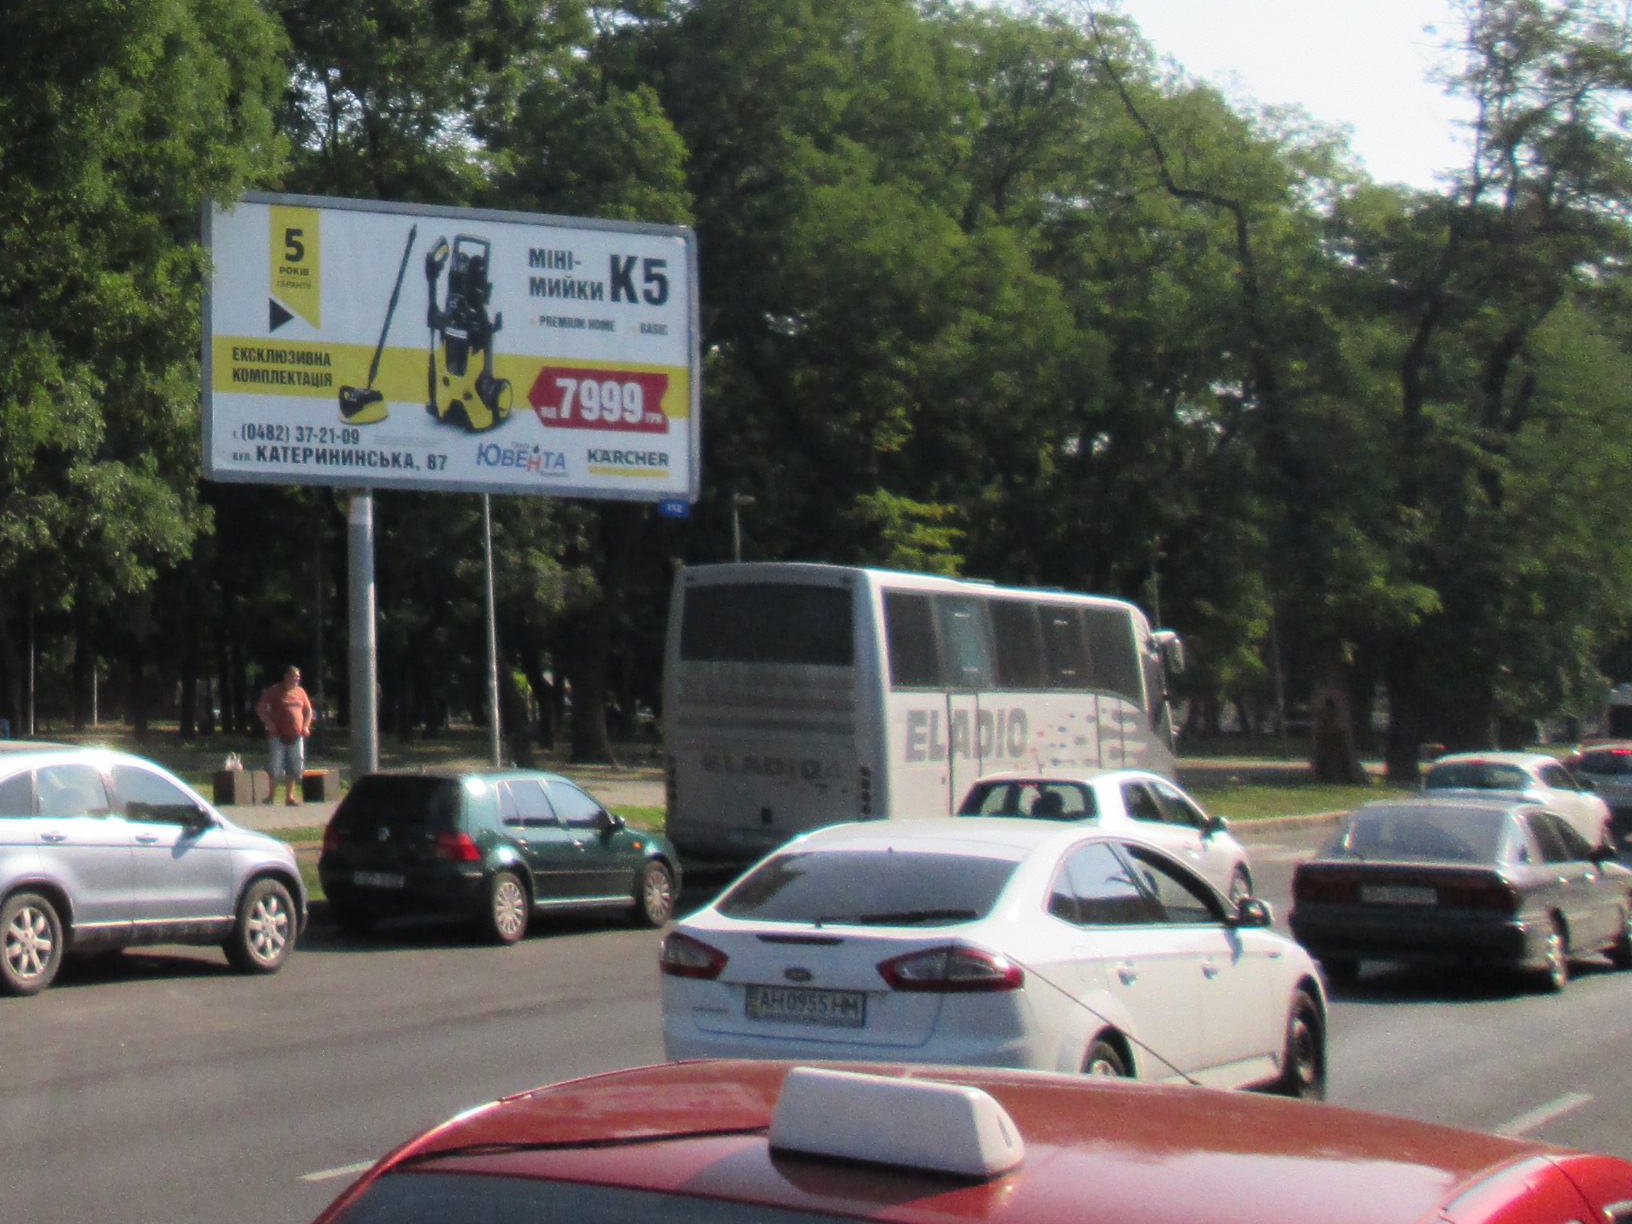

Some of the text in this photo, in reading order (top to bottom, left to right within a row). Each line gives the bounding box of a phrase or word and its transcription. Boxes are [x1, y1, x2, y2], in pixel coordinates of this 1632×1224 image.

[284, 227, 305, 263] 5
[528, 274, 604, 301] МИЙКИ
[232, 346, 332, 367] ЕКСКЛЮЗИВНА
[232, 367, 333, 388] КОМПЛЕКТАЦІЯ
[555, 378, 644, 424] 7999
[241, 424, 289, 444] (0482)
[296, 426, 360, 445] 37-21-09
[426, 454, 448, 471] 87
[905, 708, 1028, 762] ELADIO
